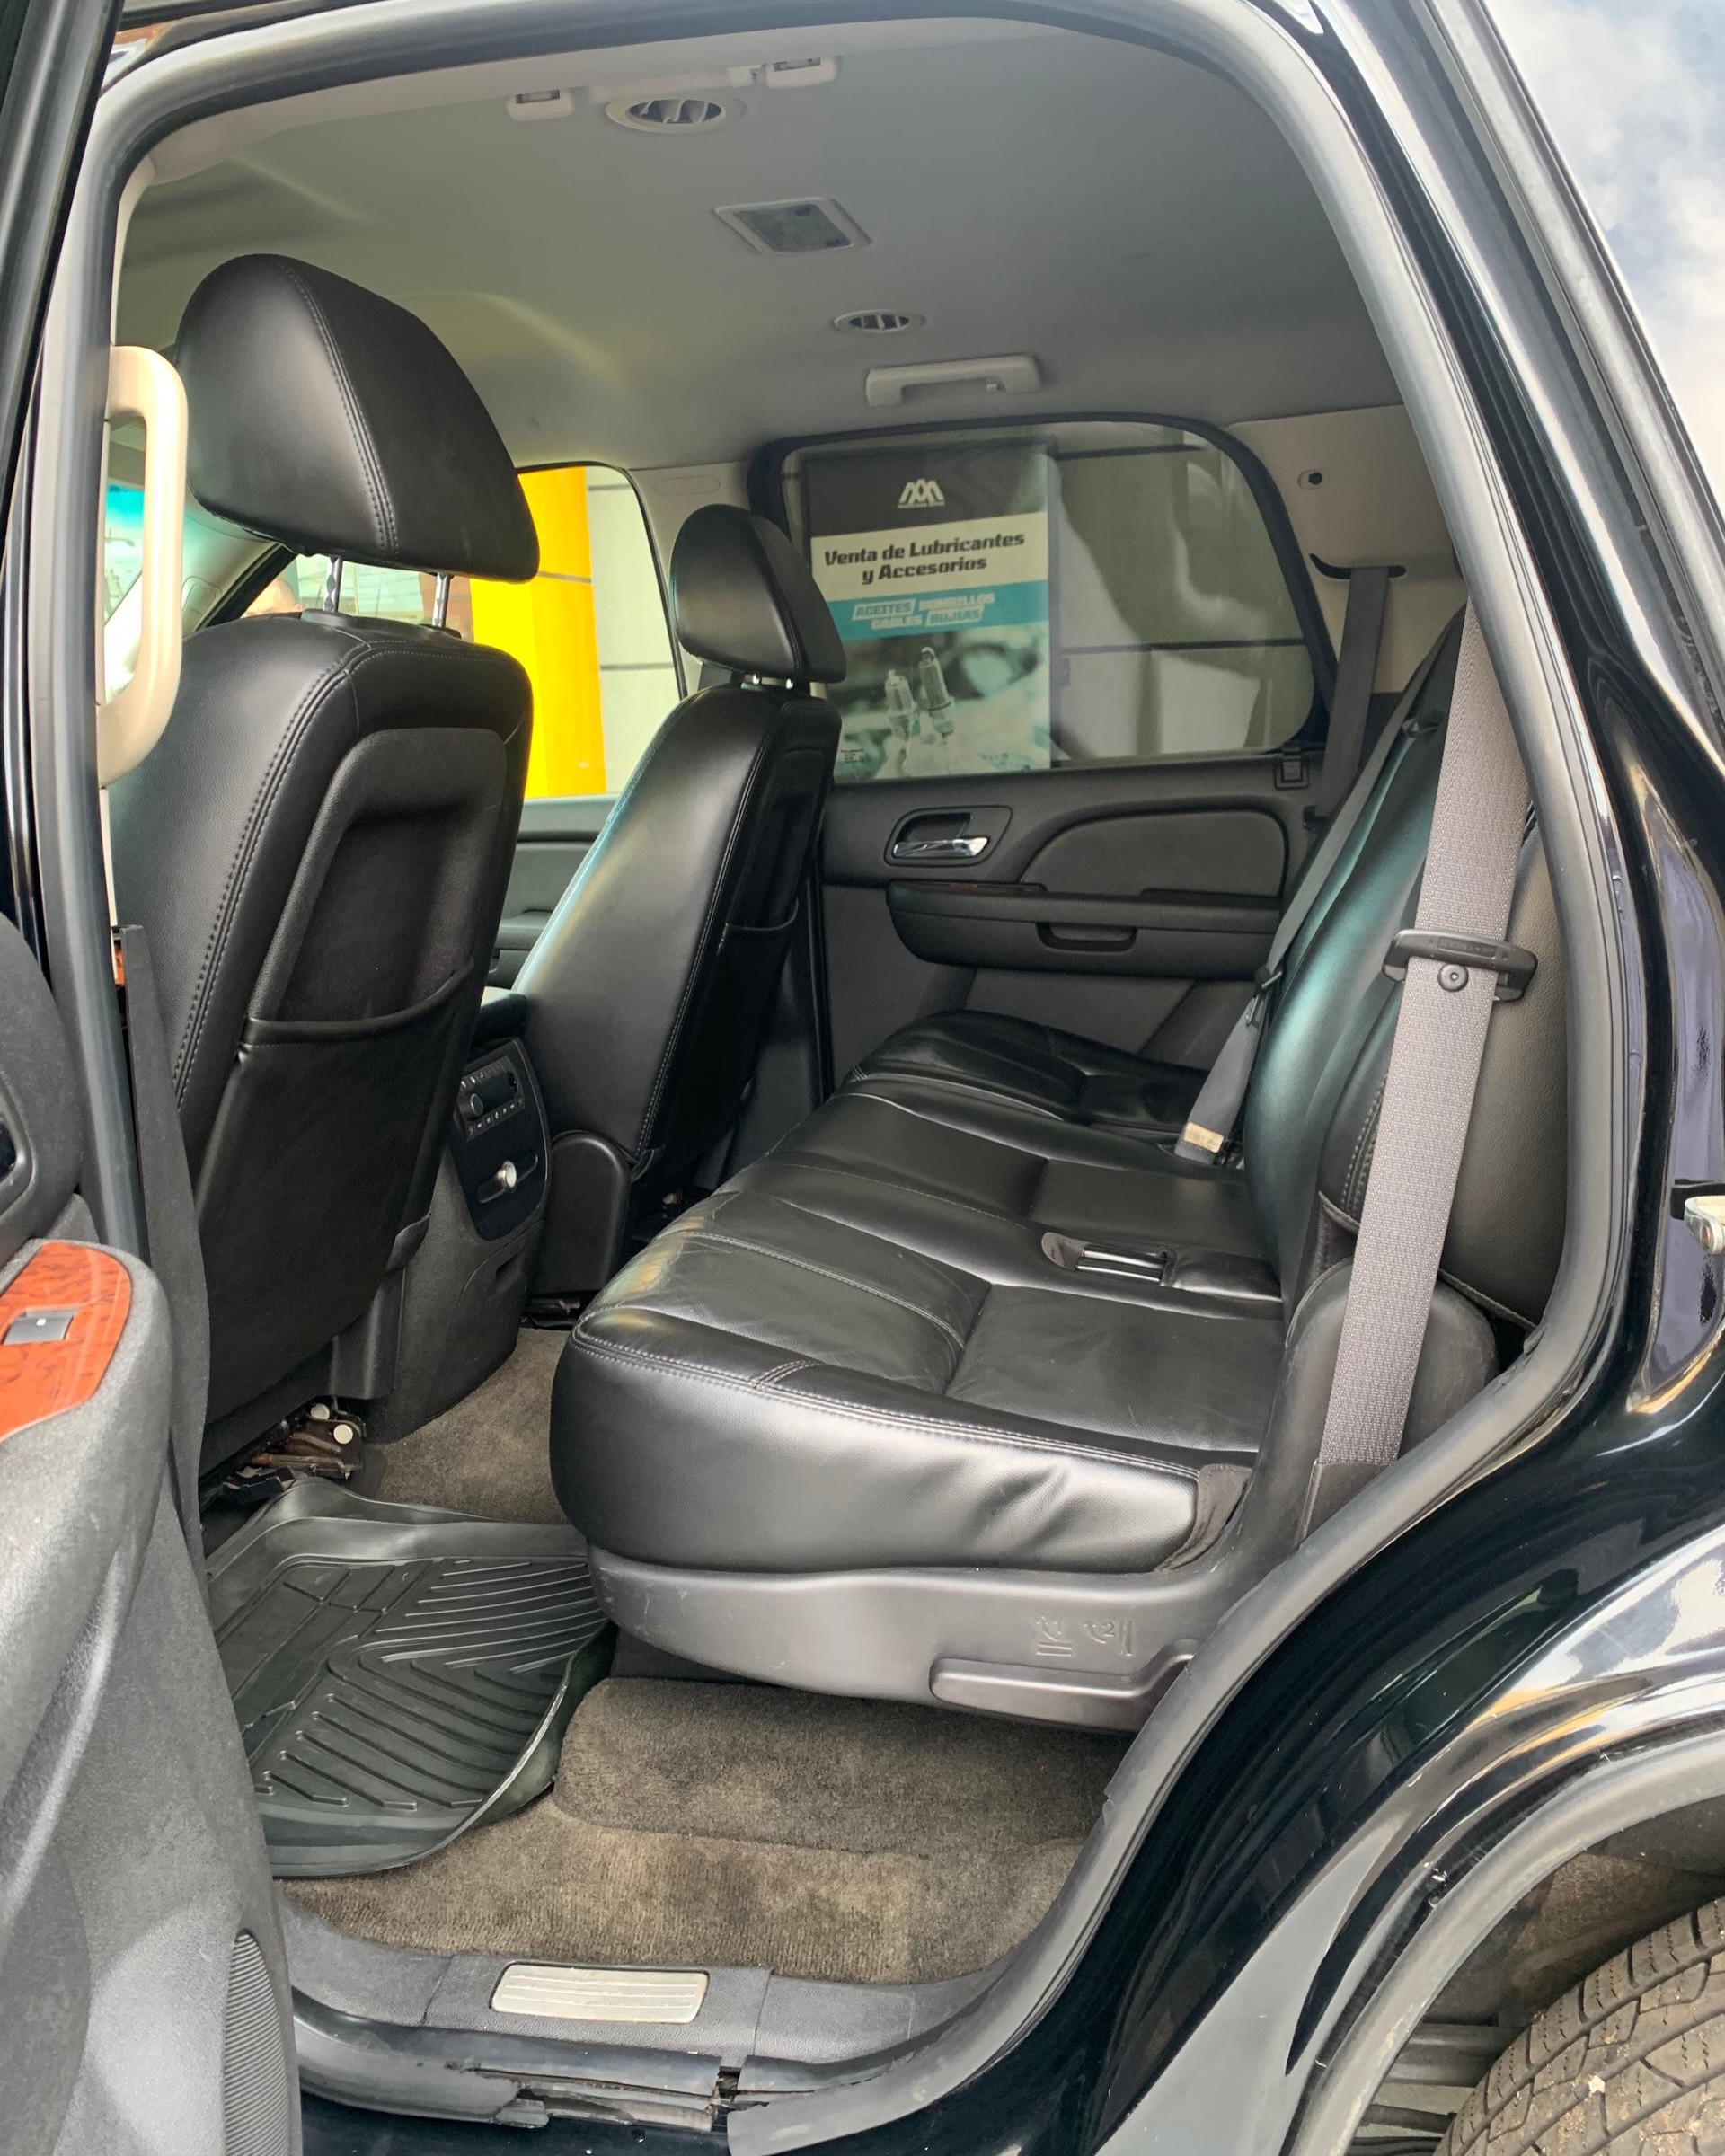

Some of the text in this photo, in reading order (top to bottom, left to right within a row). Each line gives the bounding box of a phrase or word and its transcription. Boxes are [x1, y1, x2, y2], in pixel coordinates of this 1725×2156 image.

[825, 533, 1025, 566] Venta de Lubricantes
[862, 557, 987, 585] y Accesorios
[855, 602, 912, 617] ACEITES
[1101, 1621, 1116, 1637] 2
